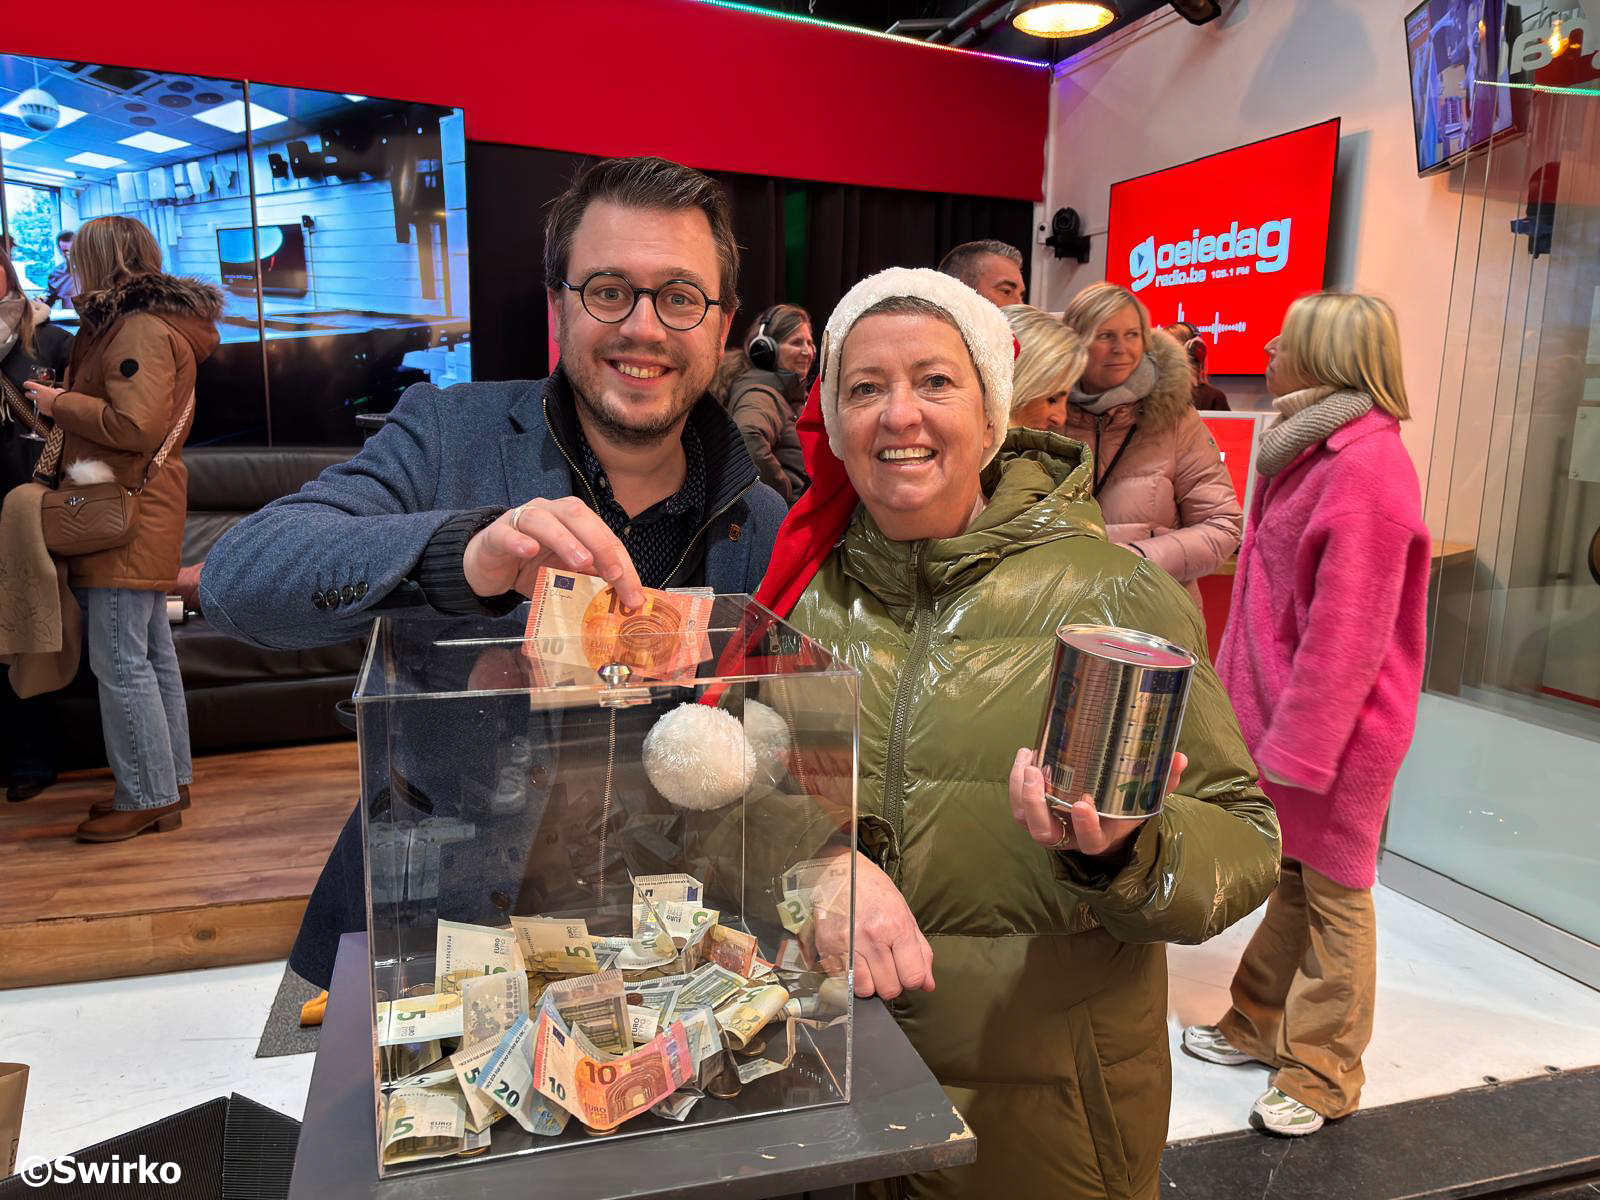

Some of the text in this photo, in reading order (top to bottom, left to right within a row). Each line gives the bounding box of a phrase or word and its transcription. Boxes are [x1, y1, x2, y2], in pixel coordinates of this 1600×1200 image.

[1129, 217, 1292, 293] goeiedag
[1155, 267, 1207, 288] radio.be
[1235, 265, 1250, 276] FM
[493, 937, 501, 954] EURO
[564, 945, 591, 958] 5
[397, 1009, 426, 1022] 5
[632, 1017, 640, 1037] EURO
[464, 1066, 481, 1085] 5
[584, 1061, 617, 1086] 10
[493, 1079, 520, 1108] 20
[549, 1076, 567, 1101] 10
[392, 1116, 415, 1138] 5
